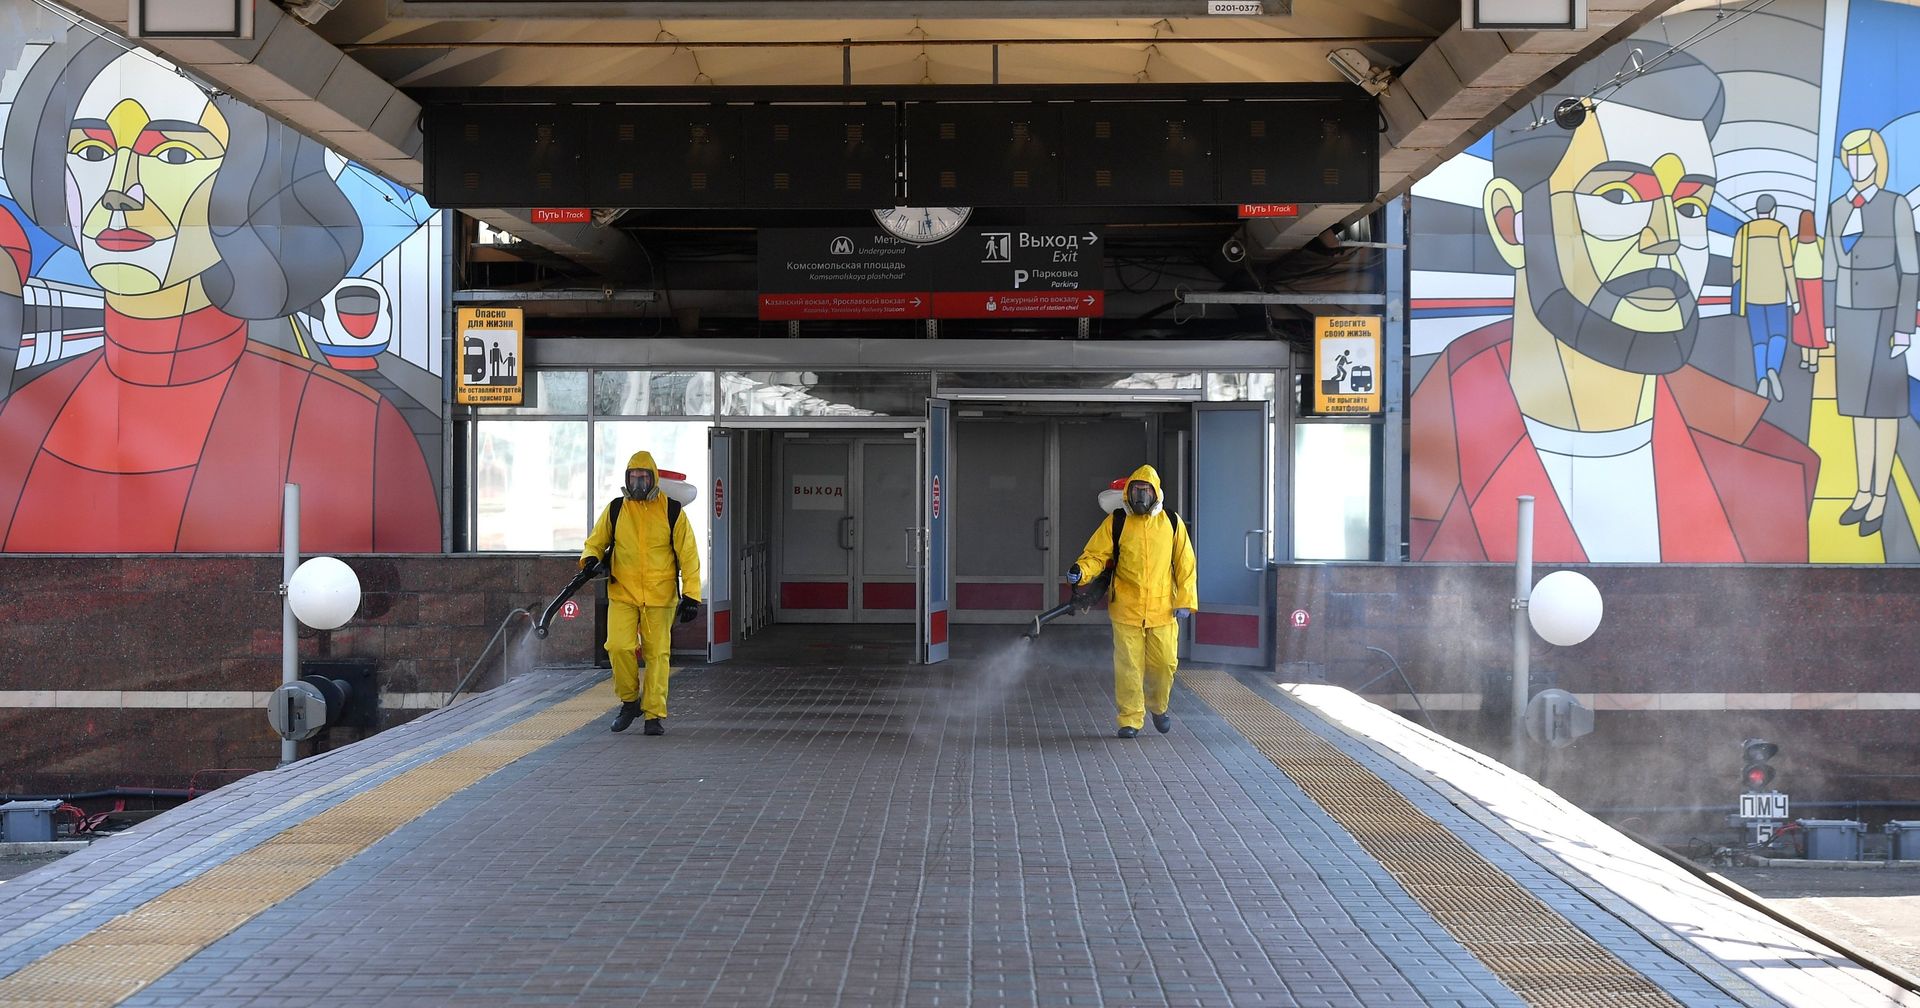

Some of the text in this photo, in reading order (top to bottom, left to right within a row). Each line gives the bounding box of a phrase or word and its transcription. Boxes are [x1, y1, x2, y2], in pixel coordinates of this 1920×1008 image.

[1215, 4, 1260, 12] 0201-0377
[1245, 205, 1266, 214] Путь
[538, 210, 559, 220] Путь
[1019, 232, 1079, 250] Выход
[858, 247, 906, 256] Underground
[1052, 250, 1078, 262] Exit
[786, 261, 906, 270] Комсомольская площадь
[809, 273, 866, 281] Komsomolskaya
[1032, 269, 1079, 279] Парковка
[1051, 281, 1078, 289] Parking
[832, 298, 879, 306] Ярославский
[475, 309, 506, 318] Опасно
[467, 319, 513, 328] для жизни
[1329, 319, 1366, 328] Берегите
[1347, 329, 1371, 337] жизнь
[503, 386, 521, 394] детей
[1337, 396, 1367, 404] прыгайте
[1331, 404, 1370, 412] платформы
[794, 486, 843, 496] ВЫХОД
[1742, 796, 1786, 816] ПМЧ
[1759, 825, 1772, 843] 5
